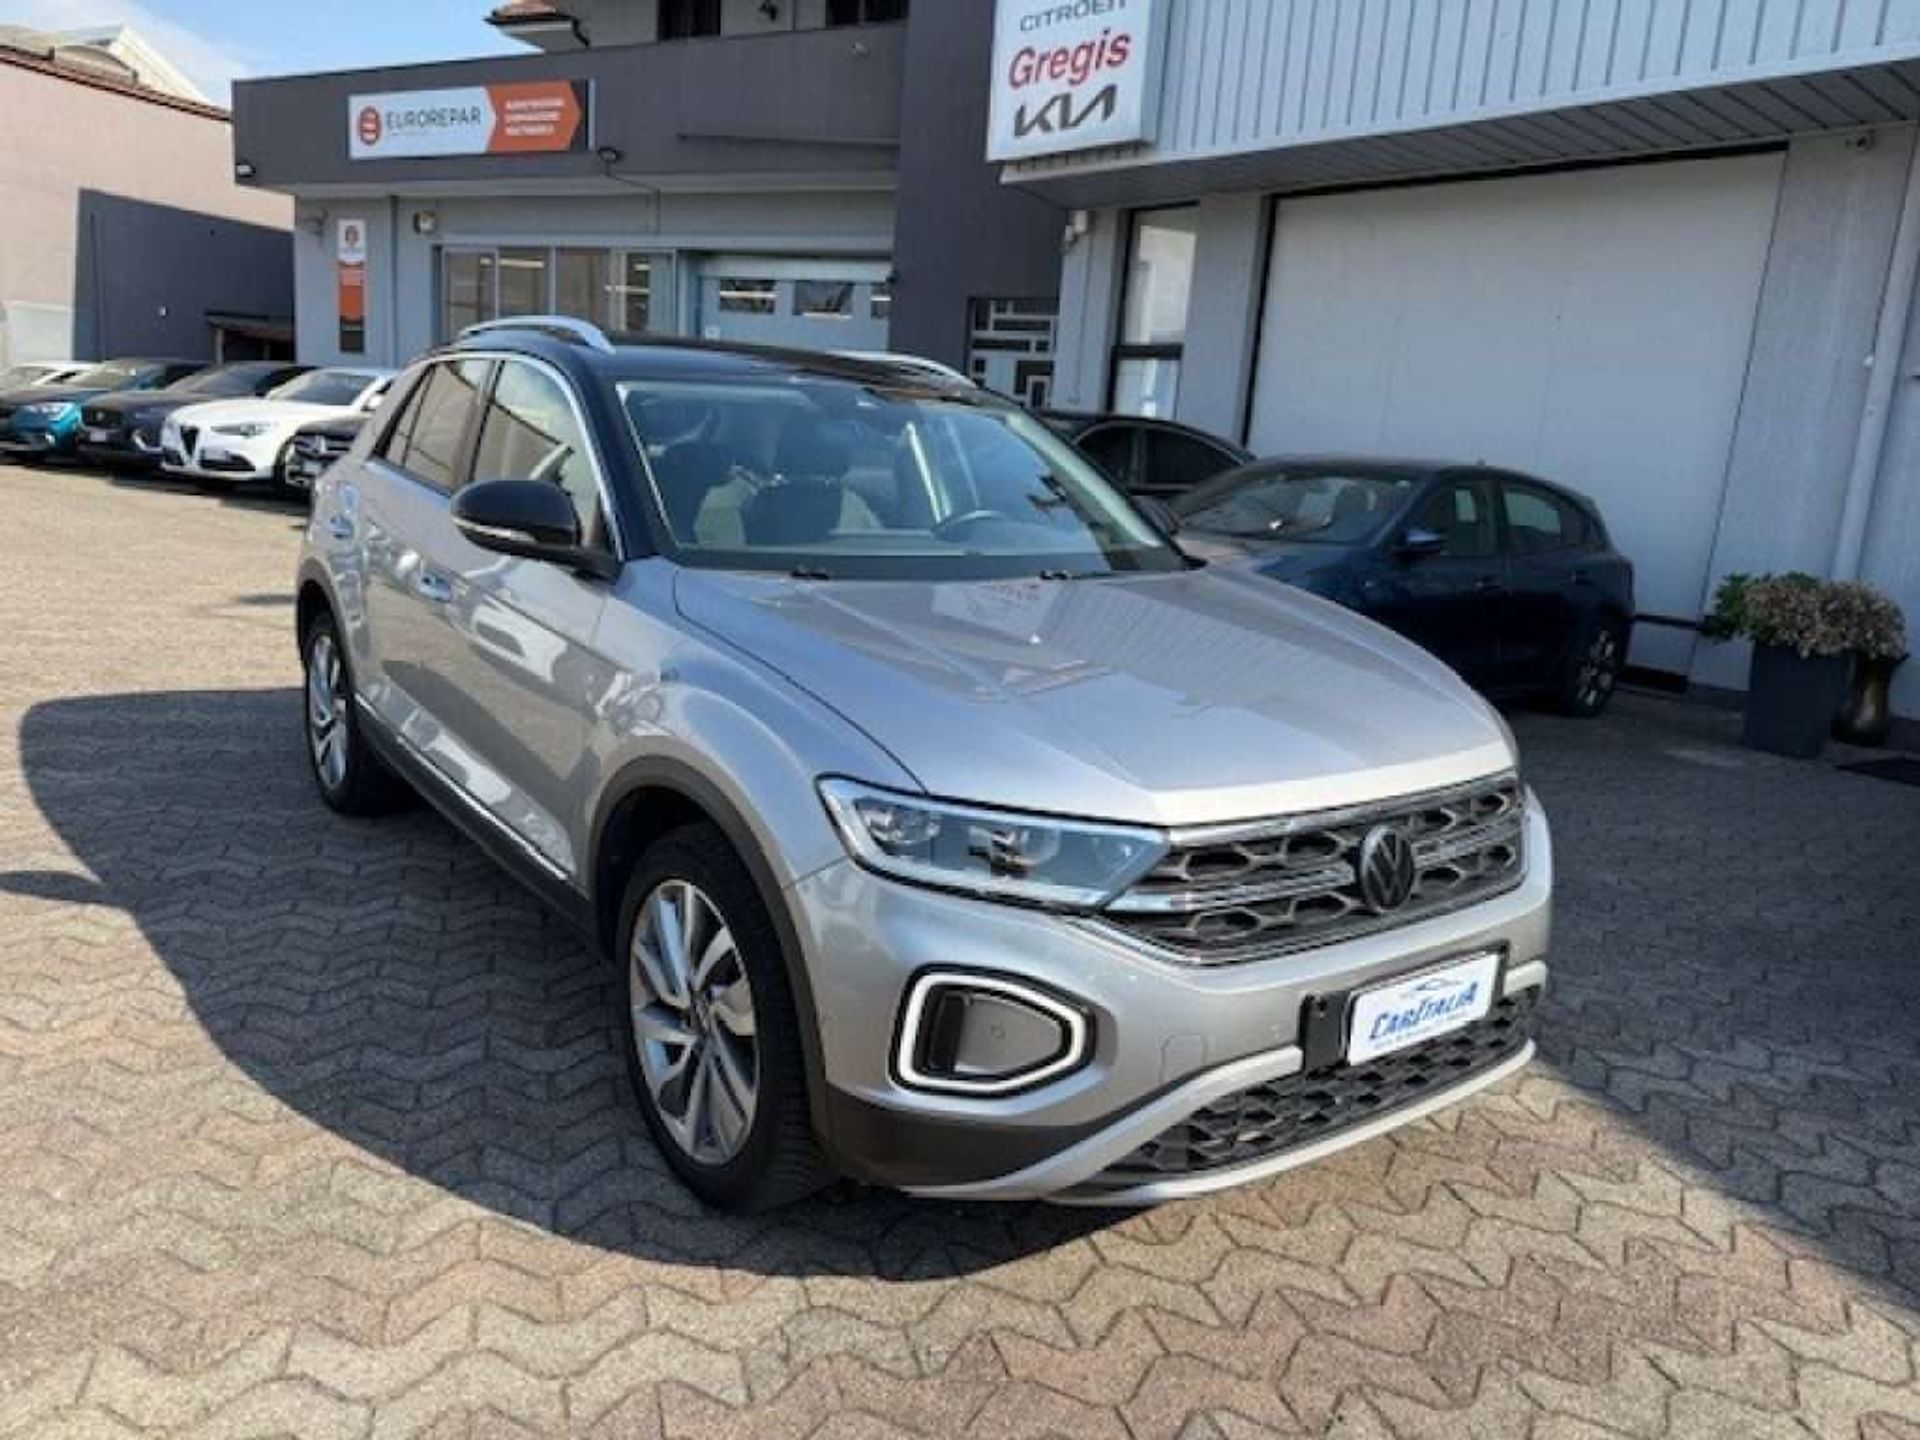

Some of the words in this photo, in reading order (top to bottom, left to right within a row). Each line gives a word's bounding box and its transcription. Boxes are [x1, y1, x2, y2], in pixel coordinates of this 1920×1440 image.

[1008, 27, 1131, 90] Gregis
[386, 106, 481, 130] EUROREPAR
[1013, 83, 1118, 138] KIA
